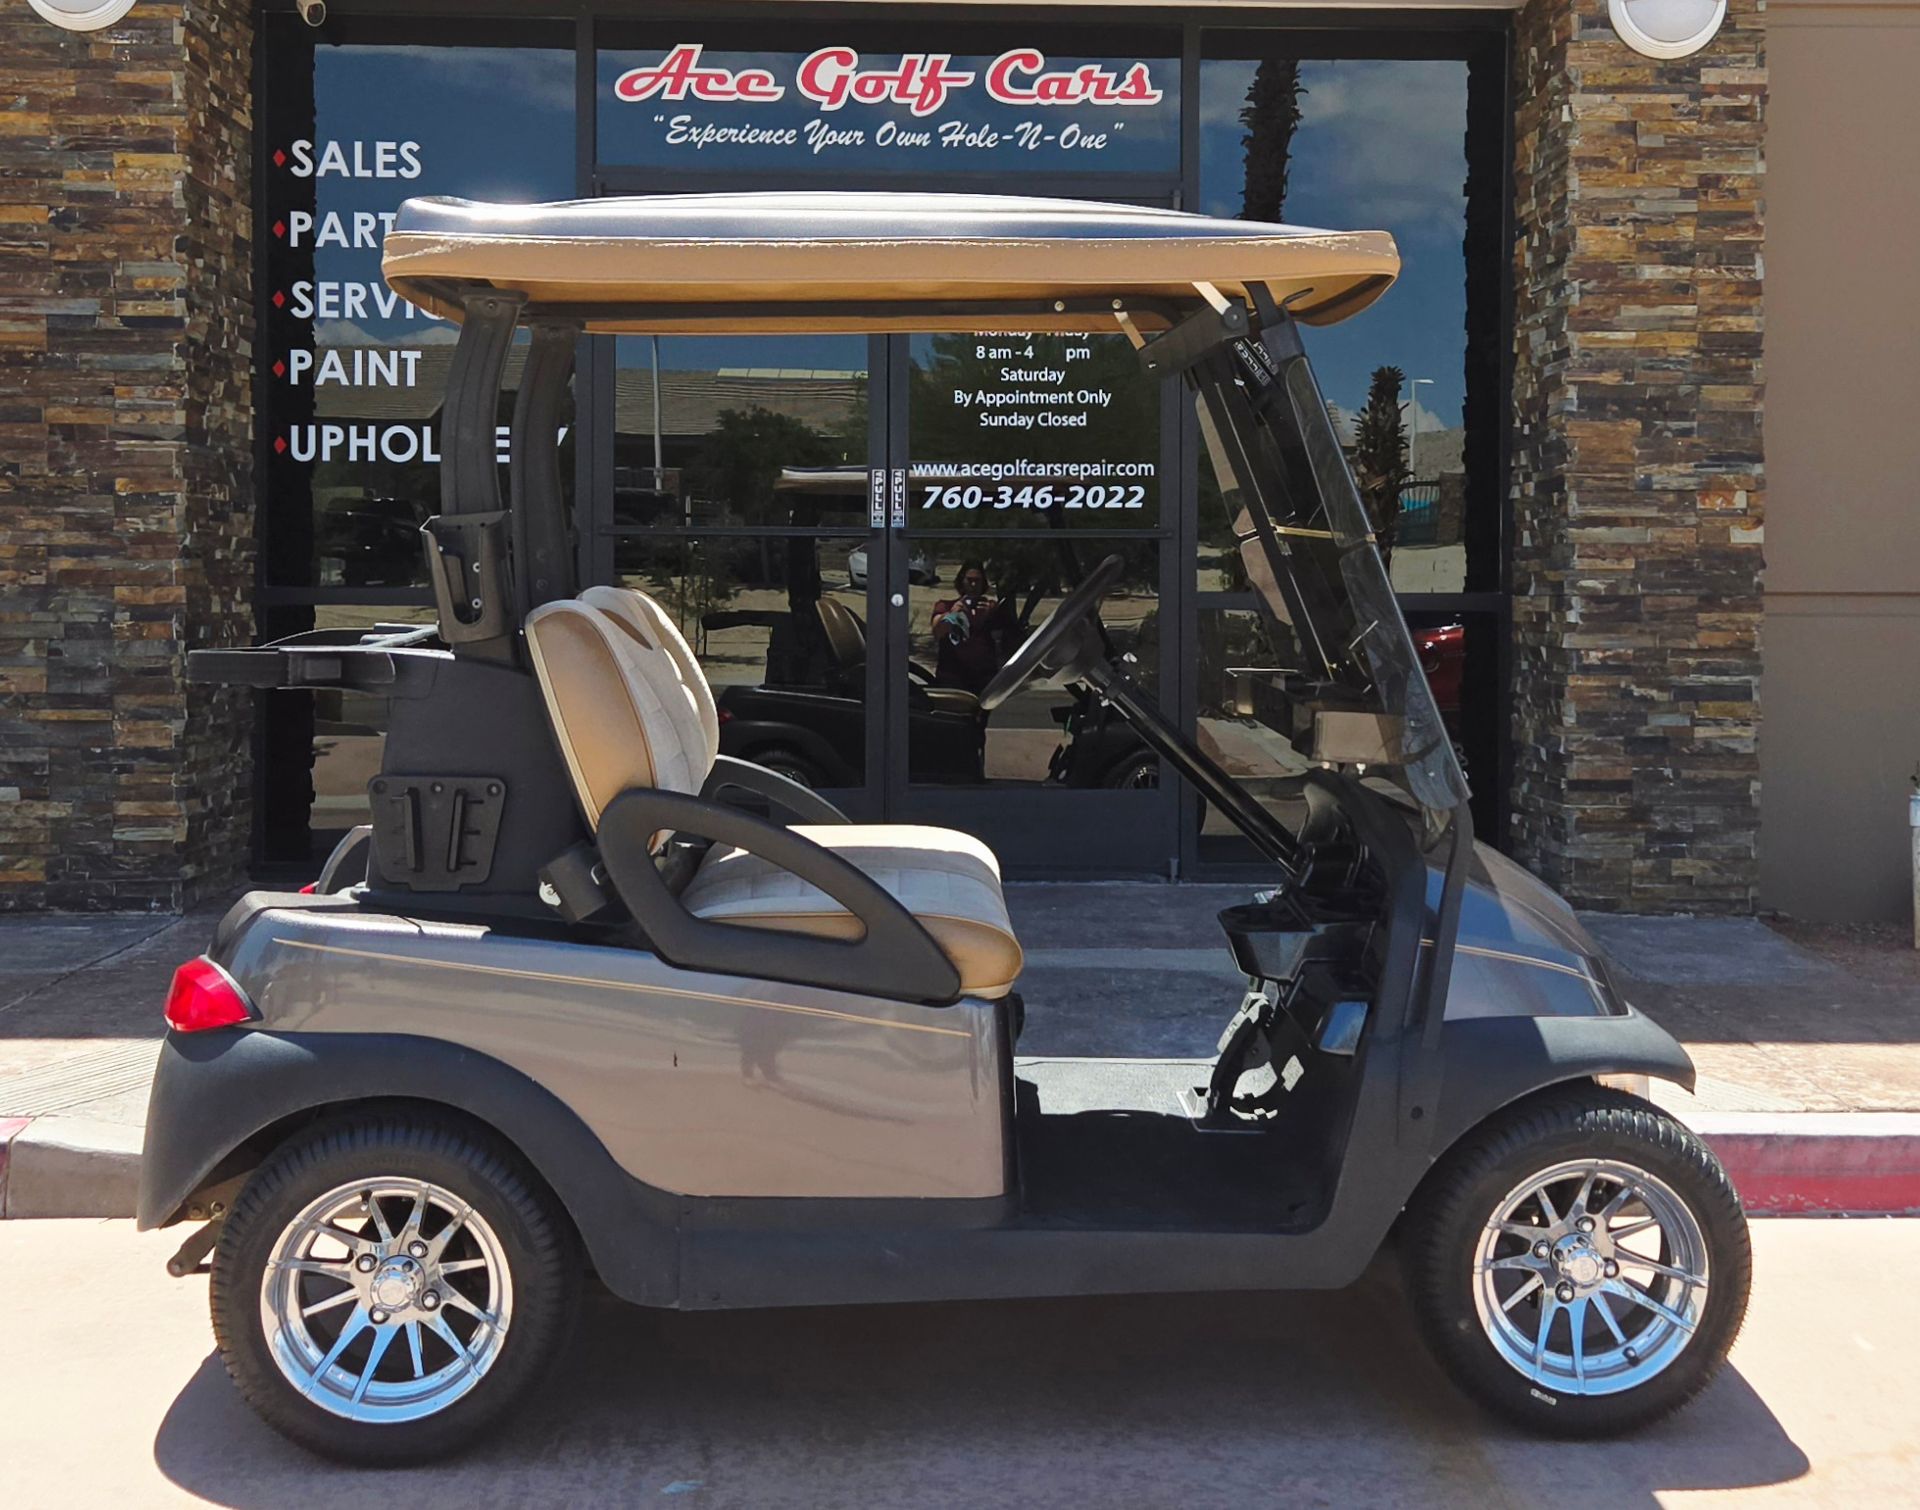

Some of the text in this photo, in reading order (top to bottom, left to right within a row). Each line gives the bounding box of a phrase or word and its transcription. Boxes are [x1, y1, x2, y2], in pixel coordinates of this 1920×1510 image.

[614, 43, 1164, 117] Ace Golf Cars
[803, 118, 866, 154] Your
[874, 120, 932, 149] Own
[290, 139, 422, 179] SALES
[290, 211, 397, 248] PART
[290, 349, 422, 387] PAINT
[976, 345, 986, 360] 8
[989, 349, 1012, 360] am
[1024, 345, 1034, 360] 4
[1065, 348, 1091, 363] pm
[1000, 367, 1066, 386] Saturday
[954, 389, 1112, 408] By Appointment Only
[979, 412, 1087, 430] Sunday Closed
[912, 459, 1155, 481] www.acegolfcarsrepair.com
[874, 476, 884, 510] PULL
[893, 476, 903, 510] PULL
[922, 485, 1145, 509] 760-346-2022
